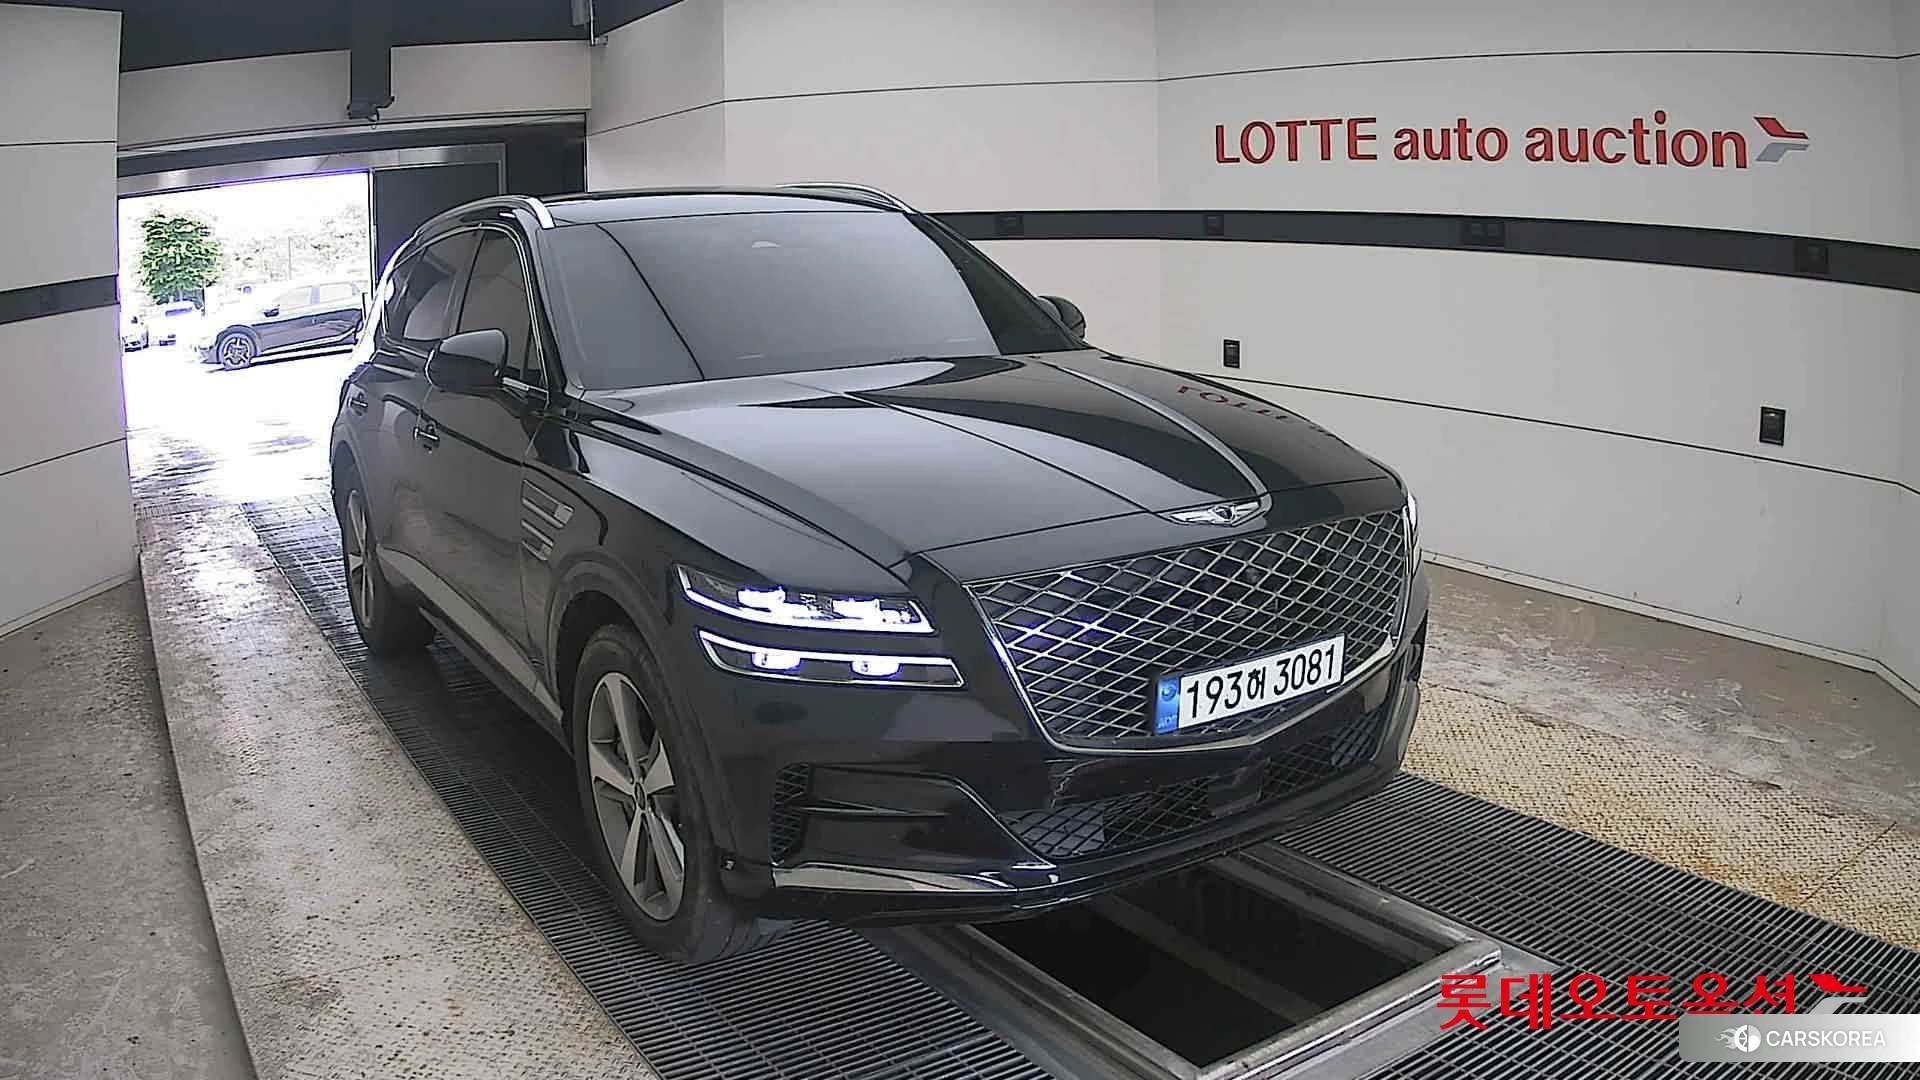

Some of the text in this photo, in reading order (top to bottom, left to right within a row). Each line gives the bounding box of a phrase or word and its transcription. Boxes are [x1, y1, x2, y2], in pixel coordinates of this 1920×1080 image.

[1215, 110, 1748, 169] LOTTE auto auction
[1273, 644, 1335, 695] 3081
